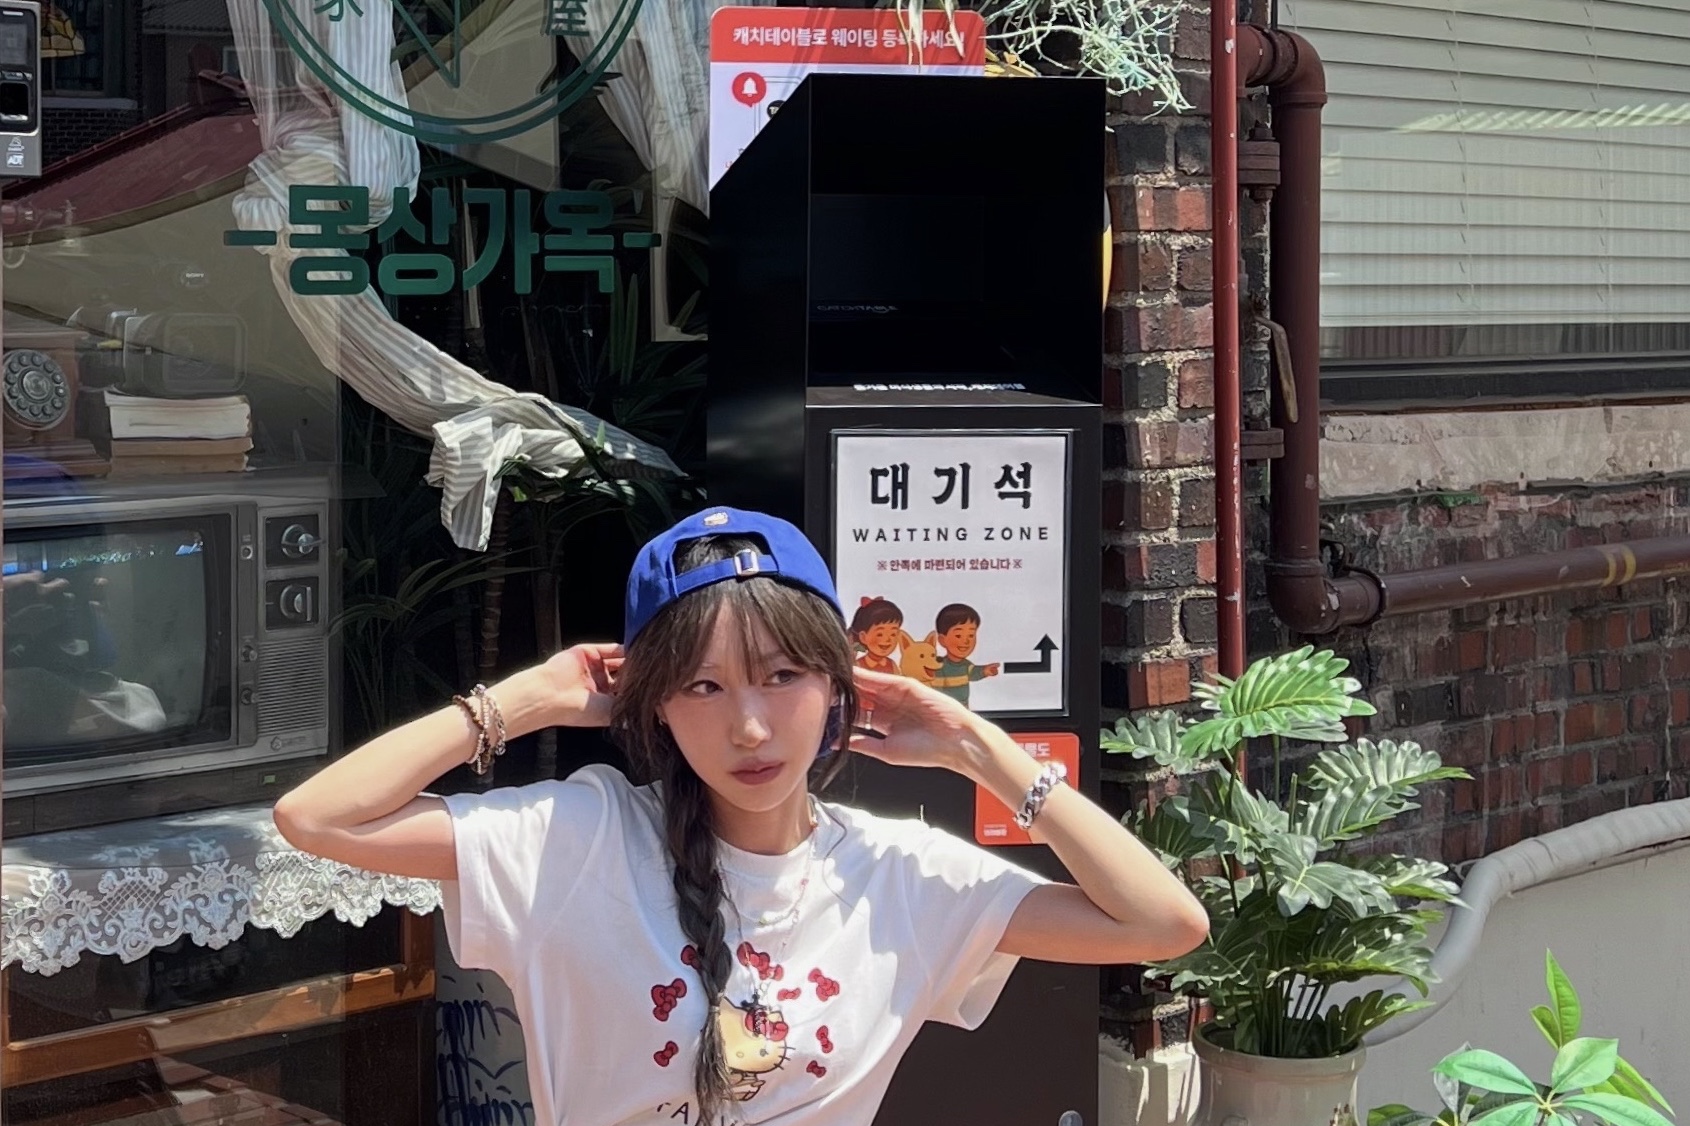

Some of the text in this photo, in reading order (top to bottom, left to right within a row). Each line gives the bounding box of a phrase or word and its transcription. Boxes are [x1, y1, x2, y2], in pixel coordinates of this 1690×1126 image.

[733, 26, 828, 47] 캐치테이블로
[831, 27, 878, 48] 웨이팅
[869, 461, 1033, 511] 대기석
[853, 526, 1049, 543] WAITING ZONE
[889, 559, 922, 572] 안쪽에
[924, 558, 967, 571] 마련되어
[969, 558, 1011, 571] 있습니다
